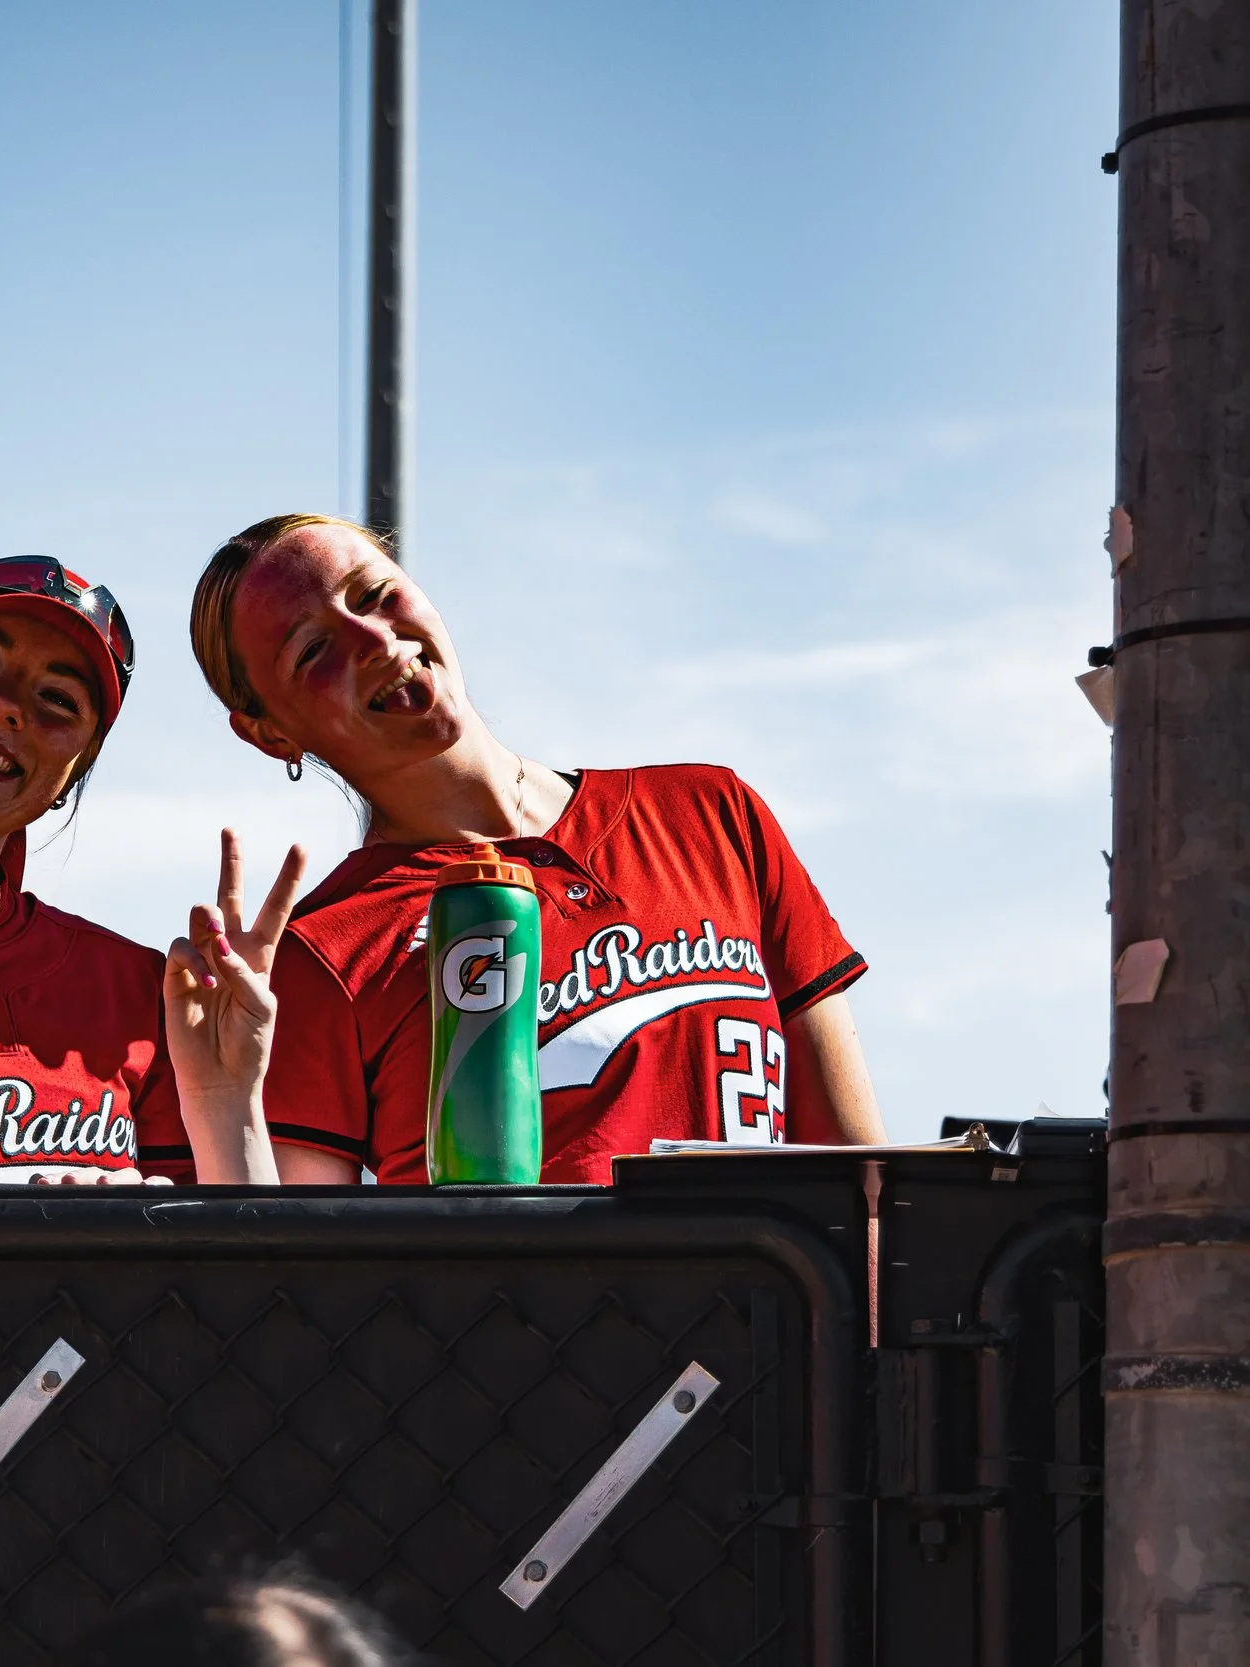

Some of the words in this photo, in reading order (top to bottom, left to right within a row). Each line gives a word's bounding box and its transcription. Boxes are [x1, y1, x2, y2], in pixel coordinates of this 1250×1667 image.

[440, 935, 507, 1013] G
[538, 948, 596, 1024] ed
[715, 1016, 786, 1143] 22
